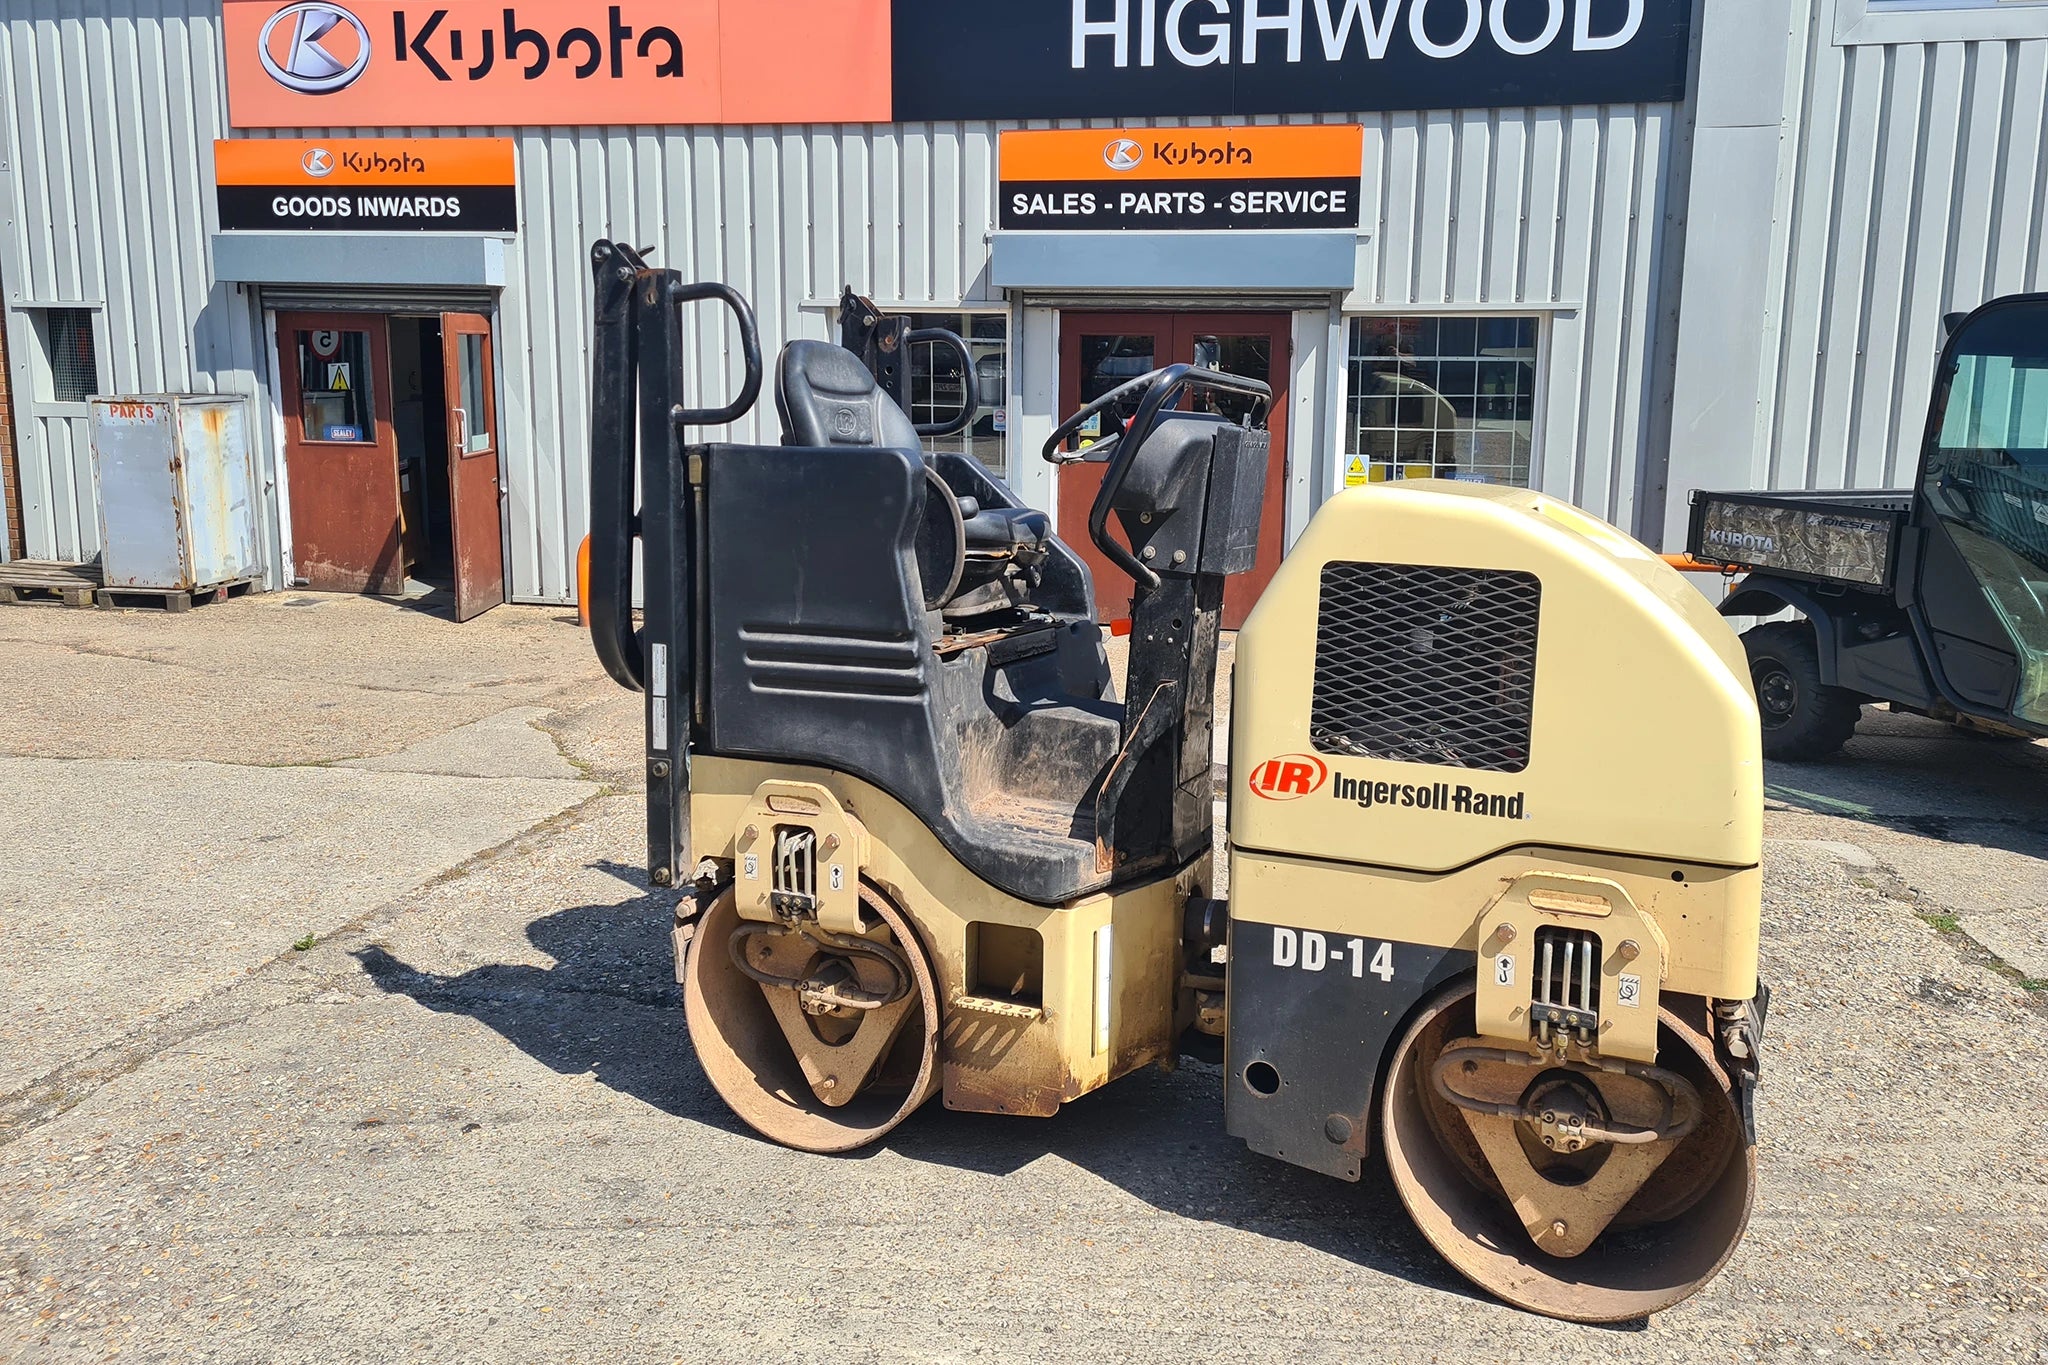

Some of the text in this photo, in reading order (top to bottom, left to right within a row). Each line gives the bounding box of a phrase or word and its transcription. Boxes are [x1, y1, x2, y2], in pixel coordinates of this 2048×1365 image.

[393, 5, 684, 81] Kubota
[1071, 0, 1645, 68] HIGHWOOD
[343, 152, 425, 172] Kubota
[1153, 141, 1252, 165] Kubota
[272, 197, 461, 217] GOODS INWARDS
[1012, 193, 1096, 215] SALES
[1120, 192, 1205, 214] PARTS
[1229, 190, 1347, 213] SERVICE
[109, 404, 154, 419] PARTS
[1823, 518, 1882, 532] DIESEL
[1709, 530, 1774, 551] KUBOTA
[1261, 760, 1315, 795] IR
[1273, 927, 1395, 982] DD-14
